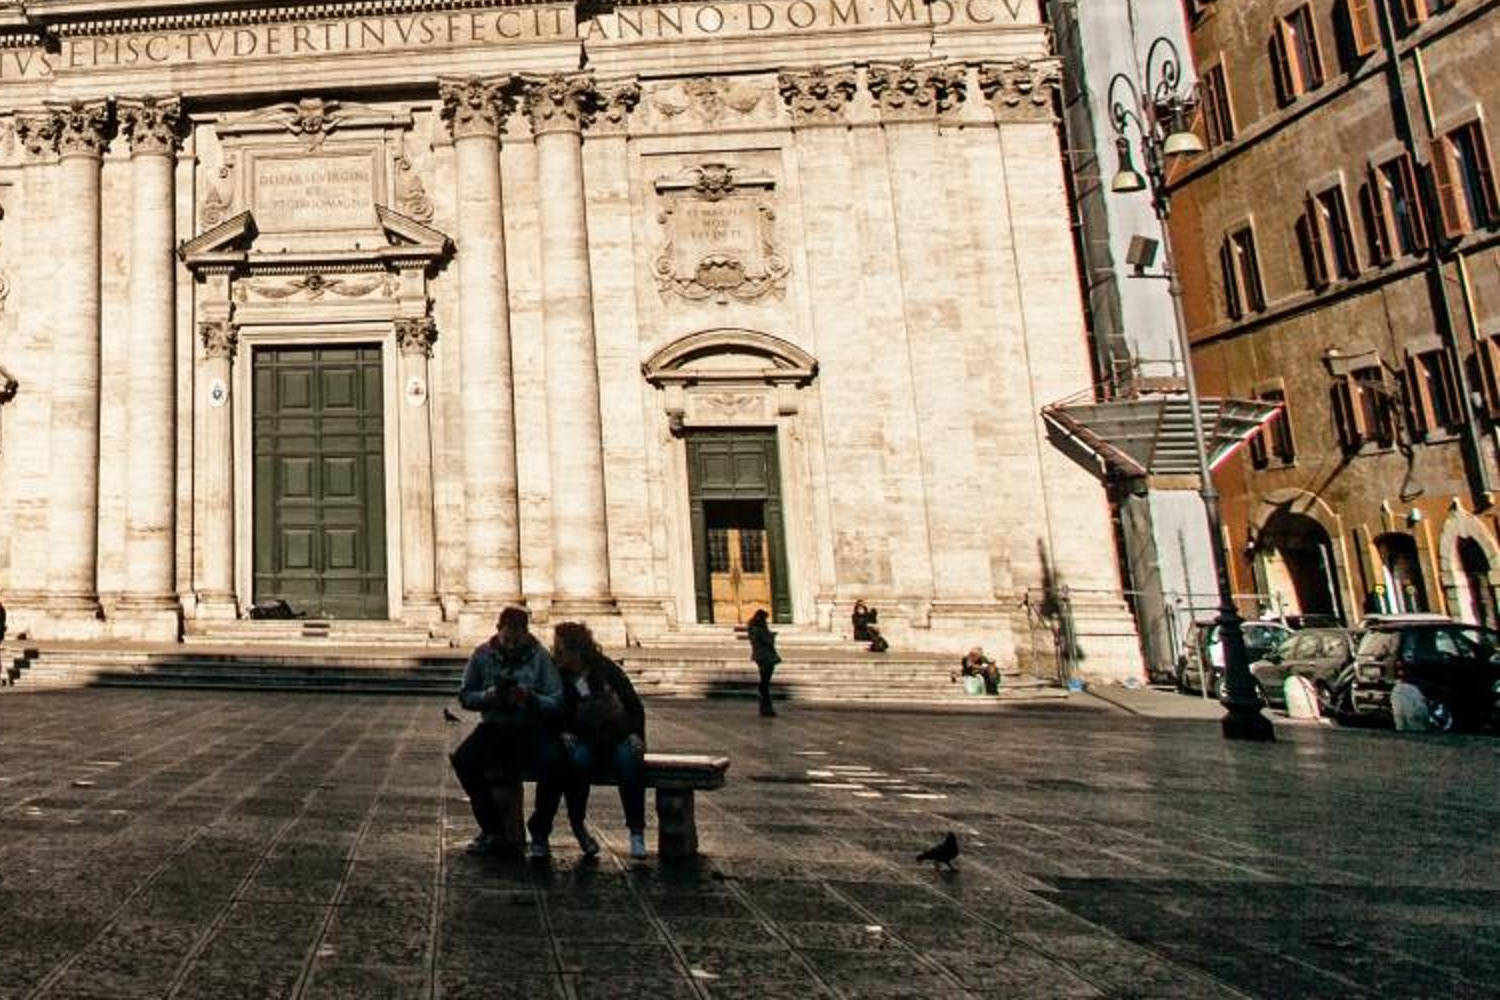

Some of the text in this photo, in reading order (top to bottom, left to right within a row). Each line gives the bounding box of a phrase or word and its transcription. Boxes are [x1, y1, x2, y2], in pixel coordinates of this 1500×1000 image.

[69, 34, 169, 67] EPISC
[180, 15, 435, 60] TVDERTINVS
[447, 7, 568, 43] FECIT
[587, 5, 725, 40] ANNO
